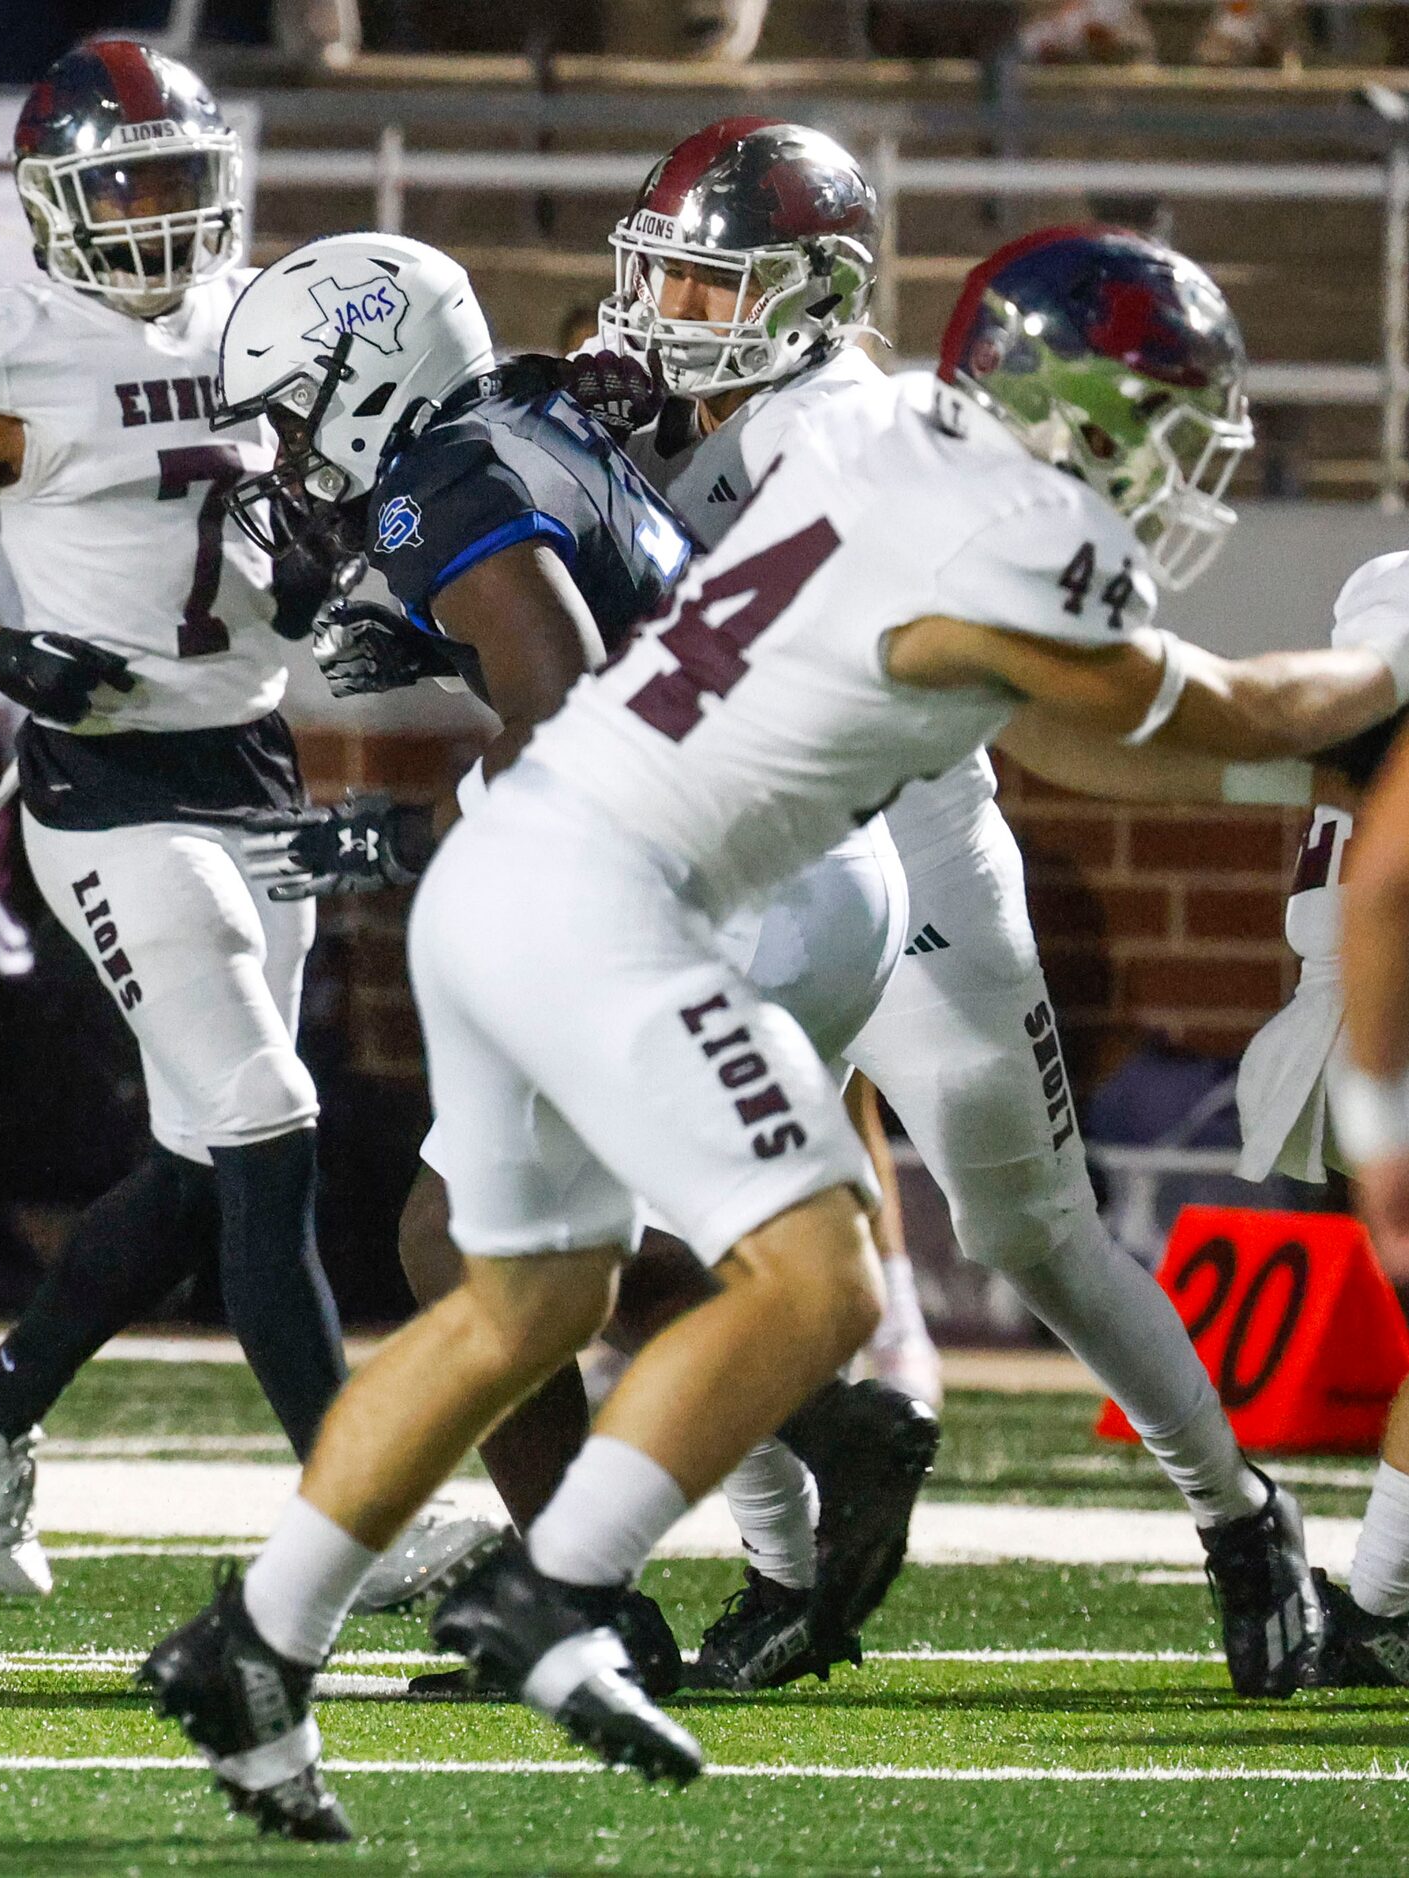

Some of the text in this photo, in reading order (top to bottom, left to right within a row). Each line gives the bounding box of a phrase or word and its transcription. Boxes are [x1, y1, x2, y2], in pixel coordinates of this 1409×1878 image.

[119, 122, 175, 143] LIONS
[635, 213, 675, 240] LIONS
[334, 286, 397, 334] JAGS
[115, 375, 226, 428] ENNI
[157, 445, 246, 659] 7
[1058, 541, 1133, 630] 44
[71, 870, 143, 1012] LIONS
[680, 993, 808, 1160] LIONS
